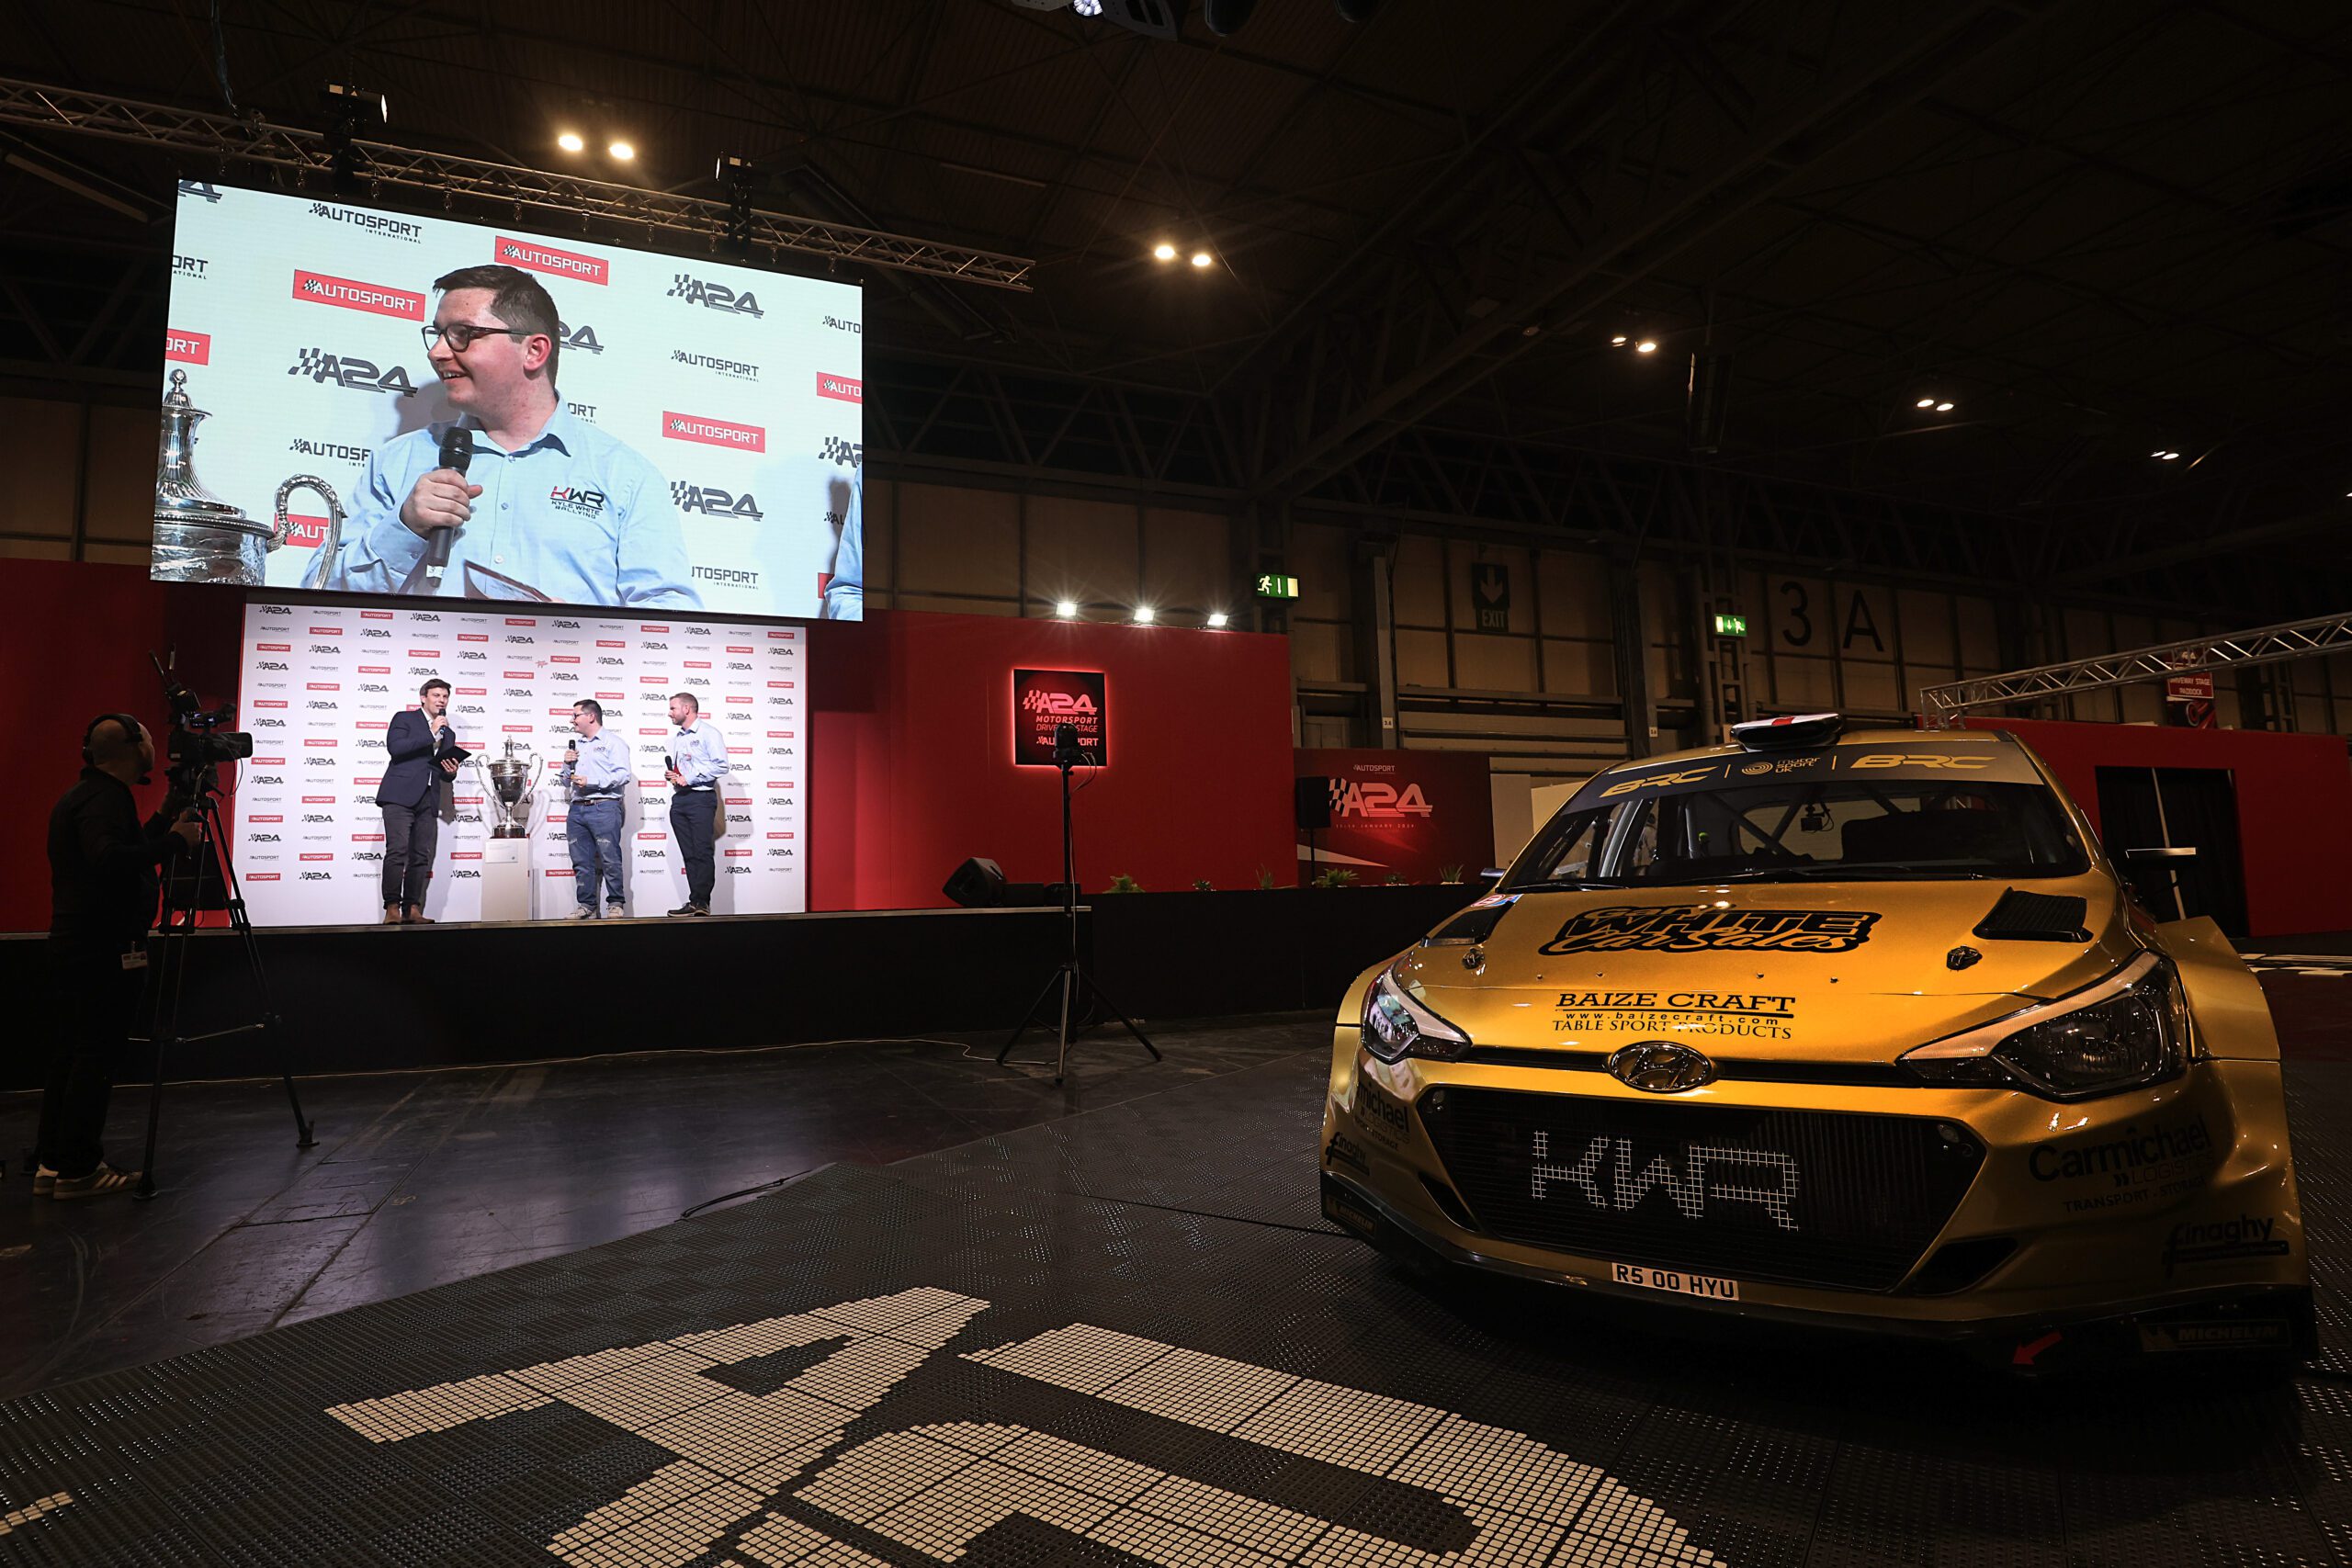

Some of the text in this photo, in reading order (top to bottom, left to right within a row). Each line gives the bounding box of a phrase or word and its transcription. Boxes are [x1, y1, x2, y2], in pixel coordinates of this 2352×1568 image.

[315, 202, 422, 238] AUTOSPORT
[366, 229, 422, 244] INTERNATIONAL
[514, 246, 602, 276] AUTOSPORT
[314, 281, 417, 312] AUTOSPORT
[681, 352, 760, 377] AUTOSPORT
[678, 420, 760, 445] AUTOSPORT
[550, 486, 605, 507] KWR
[555, 505, 595, 519] RALLYING
[575, 505, 600, 515] WHITE
[1482, 609, 1505, 627] EXIT
[1781, 581, 1884, 652] 3 A
[1035, 716, 1098, 725] MOTORSPORT
[1356, 764, 1396, 773] AUTOSPORT
[1850, 754, 1997, 770] BRC
[1600, 765, 1719, 798] BRC
[1555, 993, 1796, 1012] BAIZE CRAFT
[1552, 1020, 1603, 1031] TABLE
[1610, 1020, 1670, 1032] SPORT
[1566, 1011, 1778, 1025] www.baizecraft.com
[2029, 1112, 2212, 1182] Carmichael
[1532, 1131, 1801, 1232] KWR
[2063, 1190, 2149, 1214] TRANSPORT
[1616, 1264, 1644, 1284] R5
[1690, 1276, 1735, 1298] HYU
